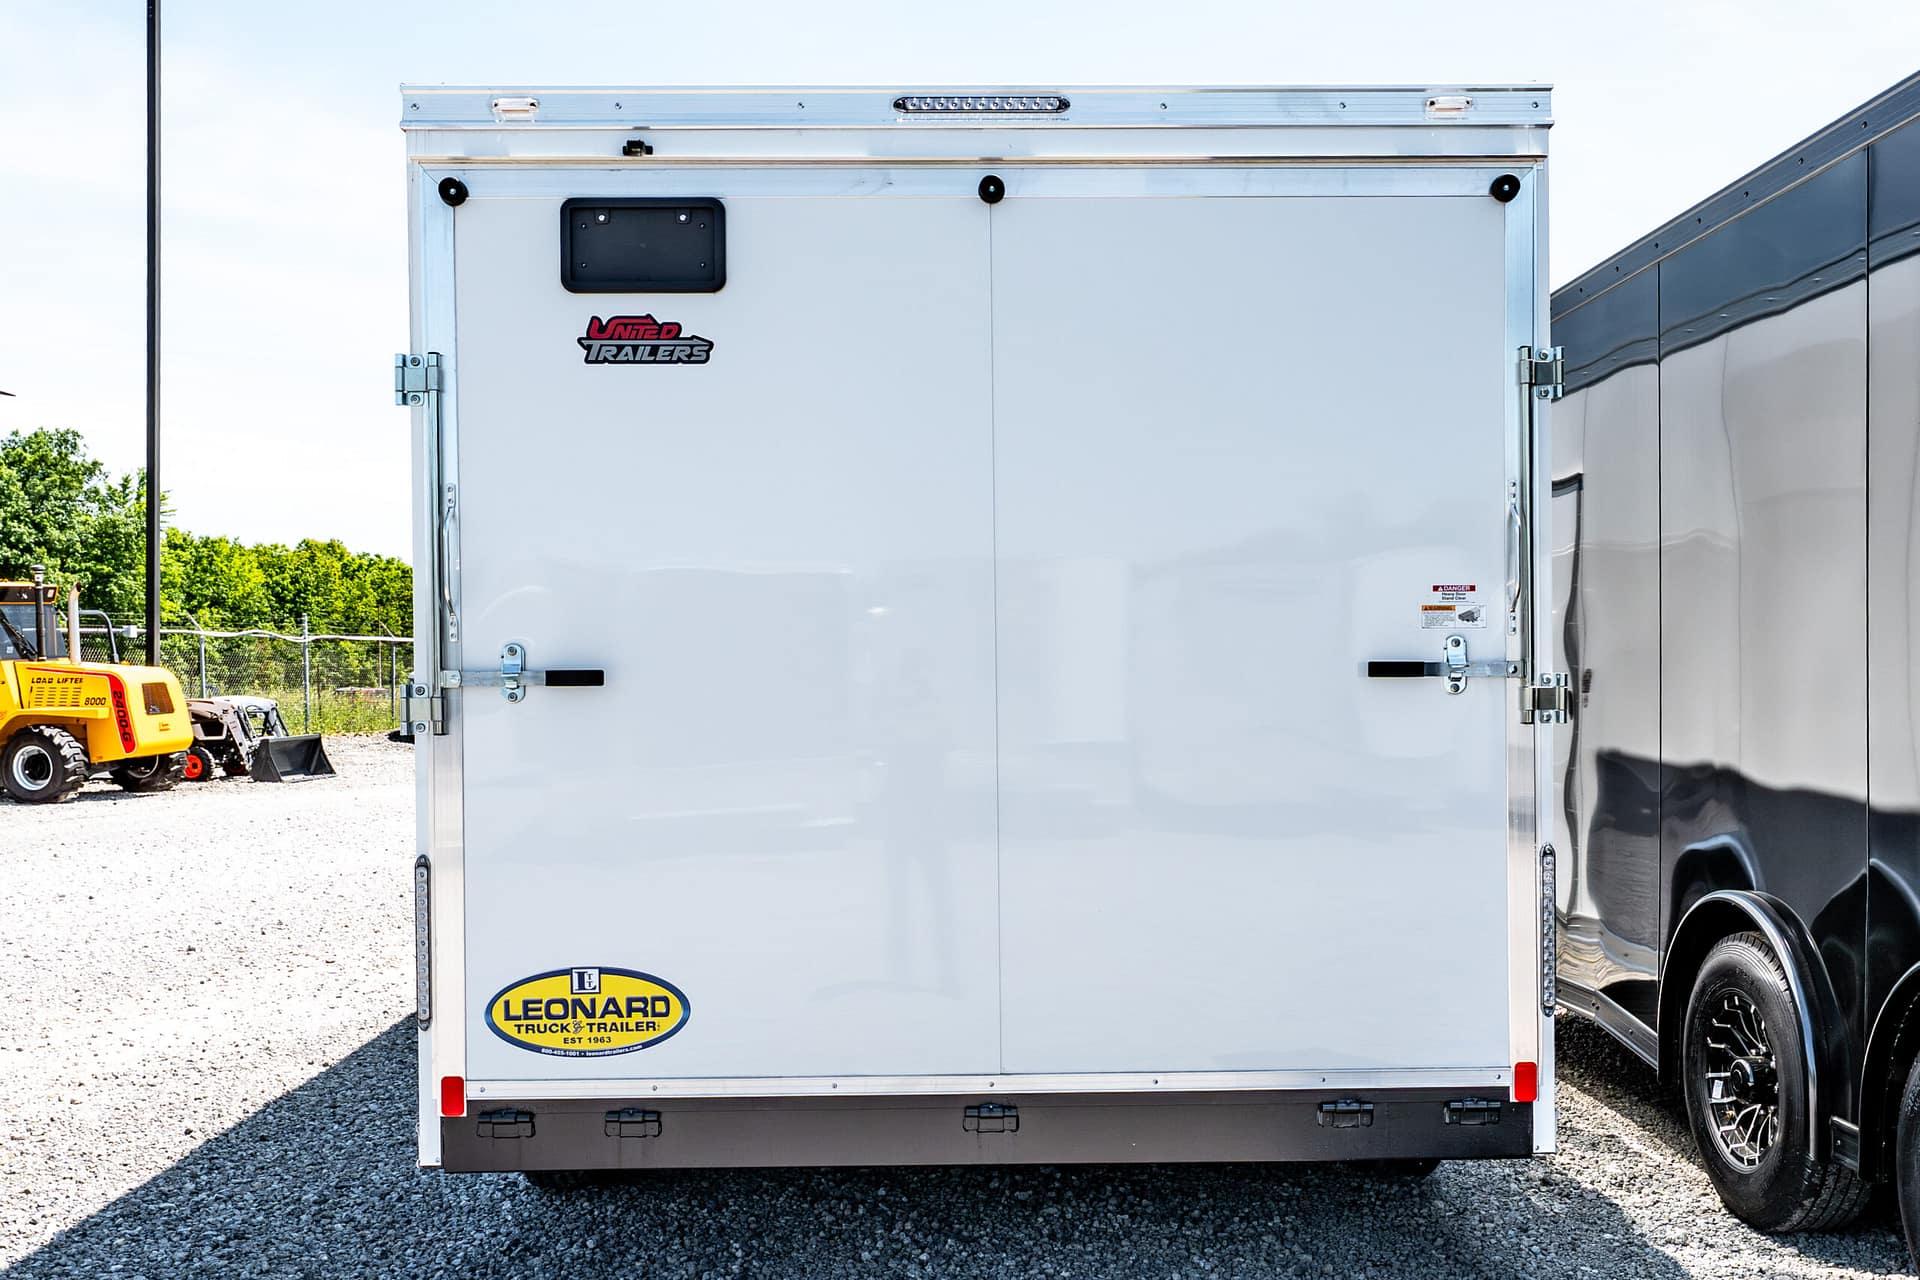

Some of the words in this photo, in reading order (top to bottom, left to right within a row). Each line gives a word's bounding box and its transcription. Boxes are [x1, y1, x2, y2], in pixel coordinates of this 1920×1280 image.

[588, 316, 680, 340] UNITED
[580, 337, 711, 361] TRAILERS
[84, 697, 107, 706] 8000
[503, 995, 671, 1021] LEONARD
[514, 1022, 572, 1034] TRUCK
[585, 1021, 656, 1033] TRAILER
[563, 1037, 583, 1045] EST
[587, 1036, 612, 1044] 1963
